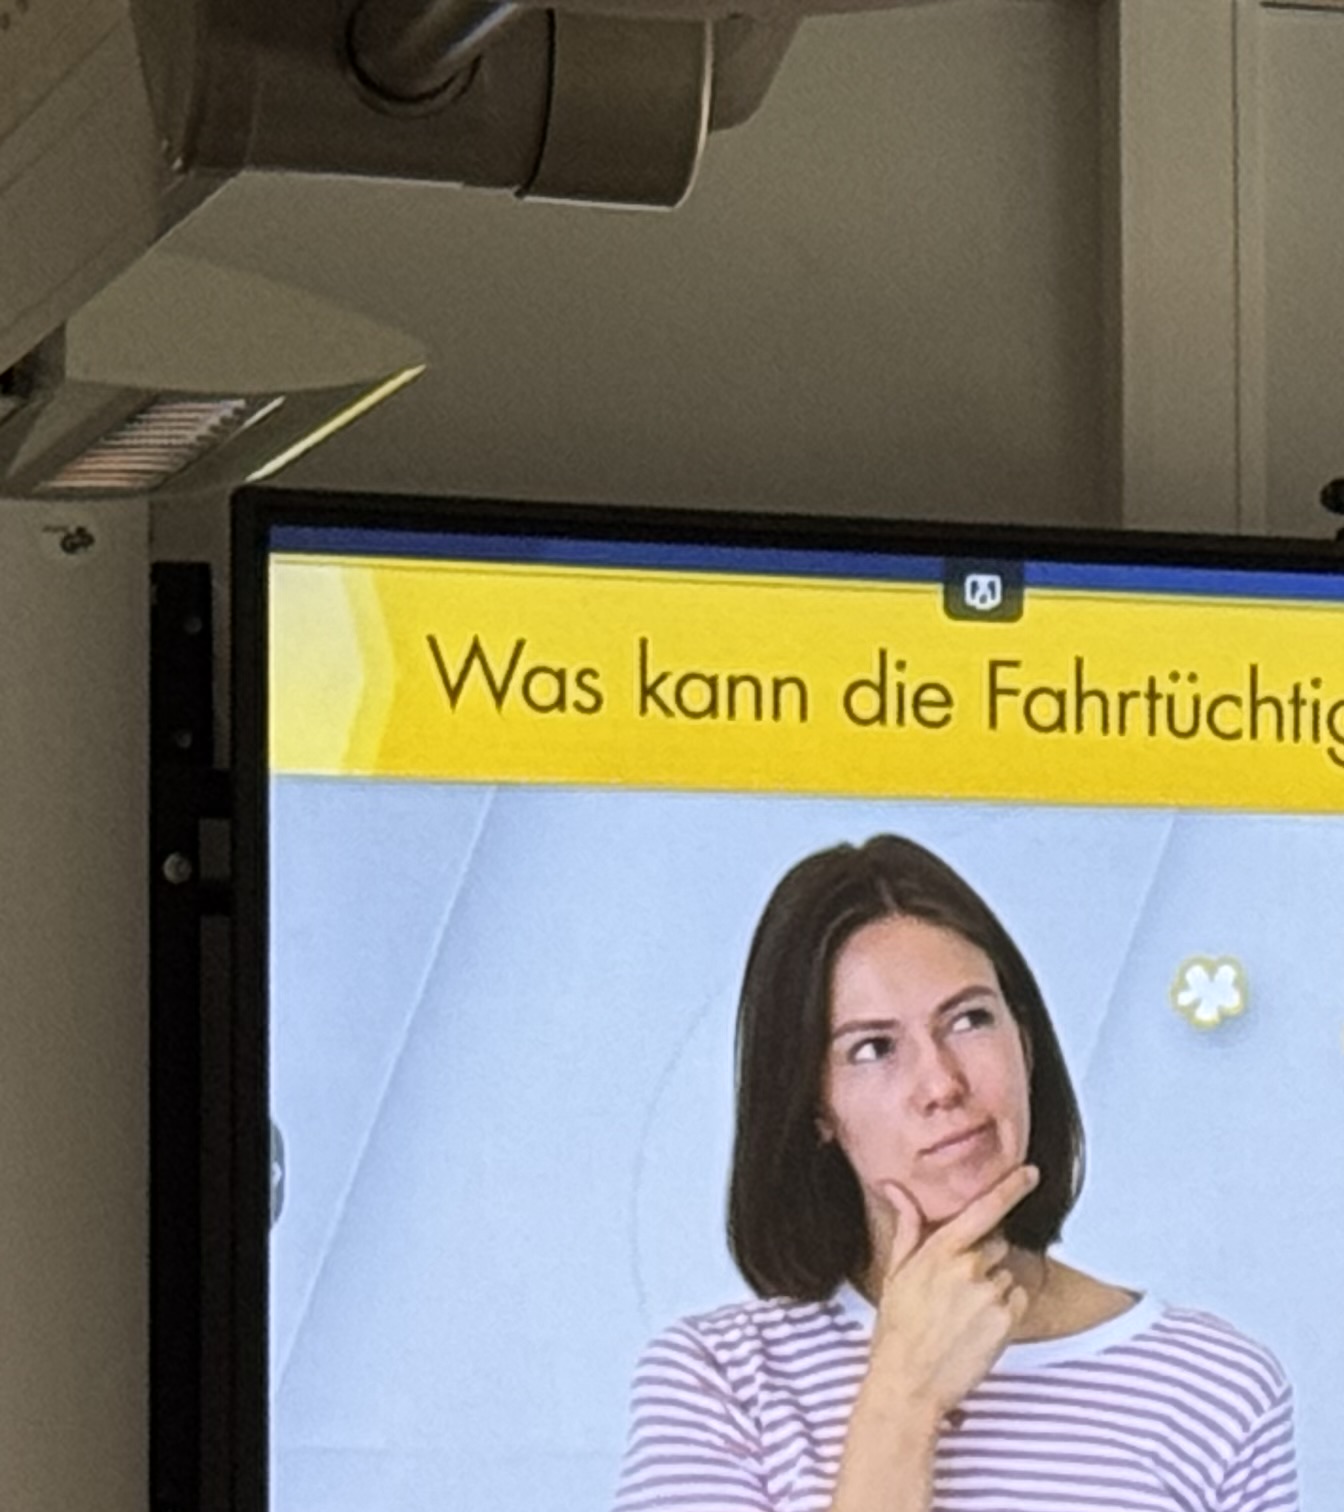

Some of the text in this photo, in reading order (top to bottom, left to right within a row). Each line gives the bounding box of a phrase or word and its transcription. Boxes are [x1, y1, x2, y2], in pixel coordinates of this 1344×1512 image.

[426, 634, 604, 715] Was
[638, 636, 809, 723] kann
[842, 647, 955, 730] die
